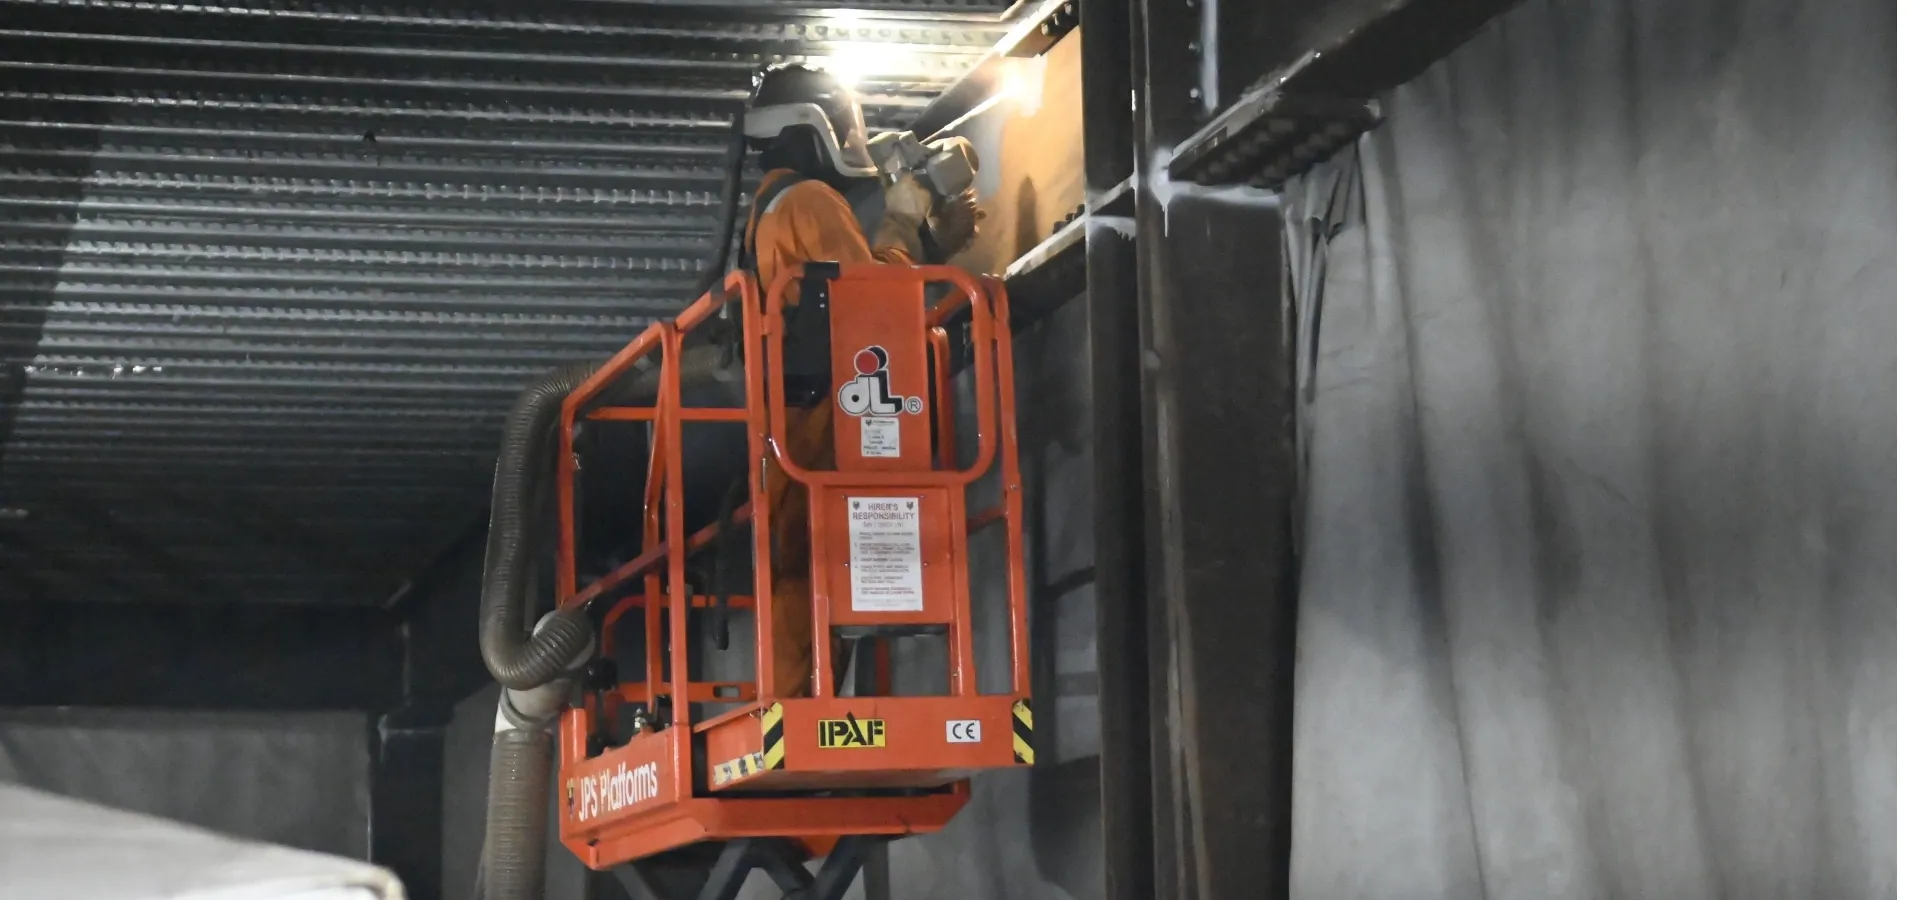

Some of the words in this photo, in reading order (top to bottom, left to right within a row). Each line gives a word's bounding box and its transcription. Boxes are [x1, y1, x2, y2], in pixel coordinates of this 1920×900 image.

[852, 512, 915, 520] RESPONSIBILITY
[819, 711, 883, 746] IPAF
[952, 722, 975, 740] CE
[578, 774, 598, 822] JPS
[600, 761, 658, 813] Platforms
